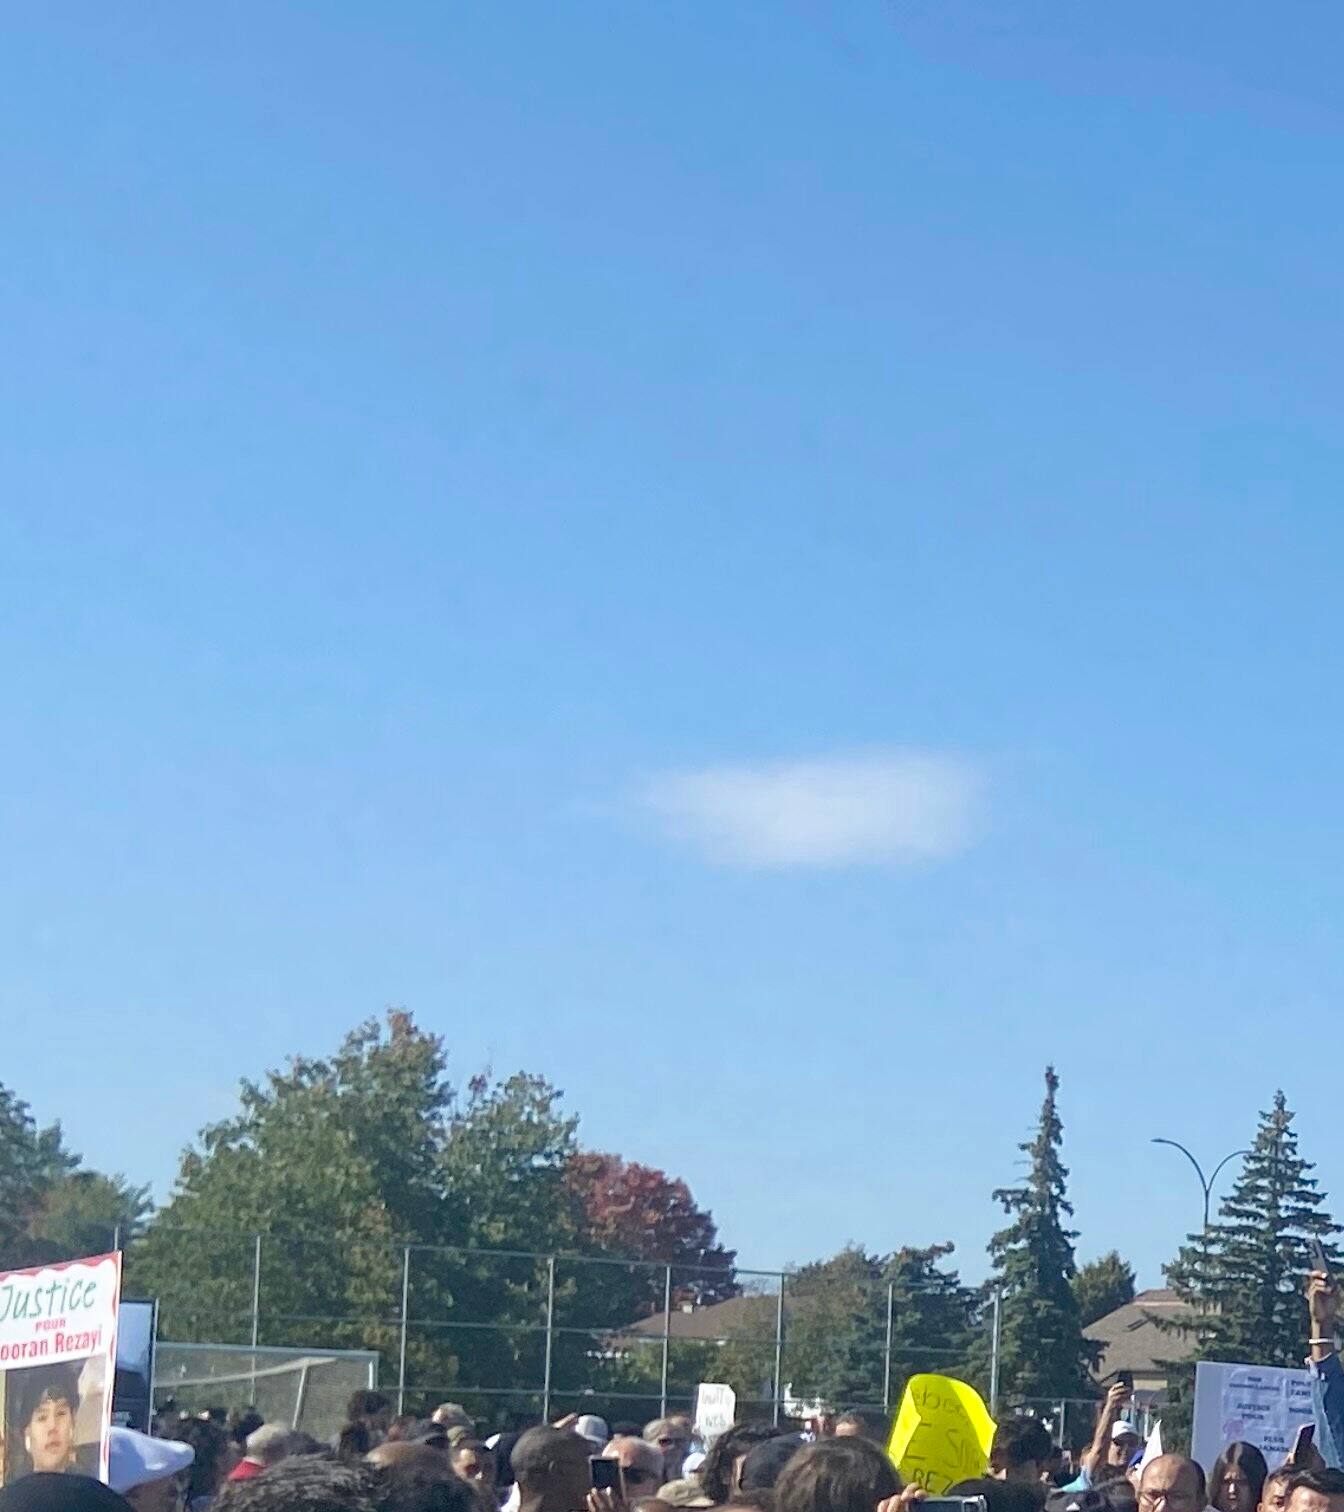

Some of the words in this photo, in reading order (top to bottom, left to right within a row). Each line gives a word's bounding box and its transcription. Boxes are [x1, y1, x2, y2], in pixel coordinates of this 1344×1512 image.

[0, 1276, 97, 1322] Justice
[0, 1339, 48, 1361] ooran
[55, 1324, 103, 1354] Rezayi
[35, 1318, 66, 1333] POUR
